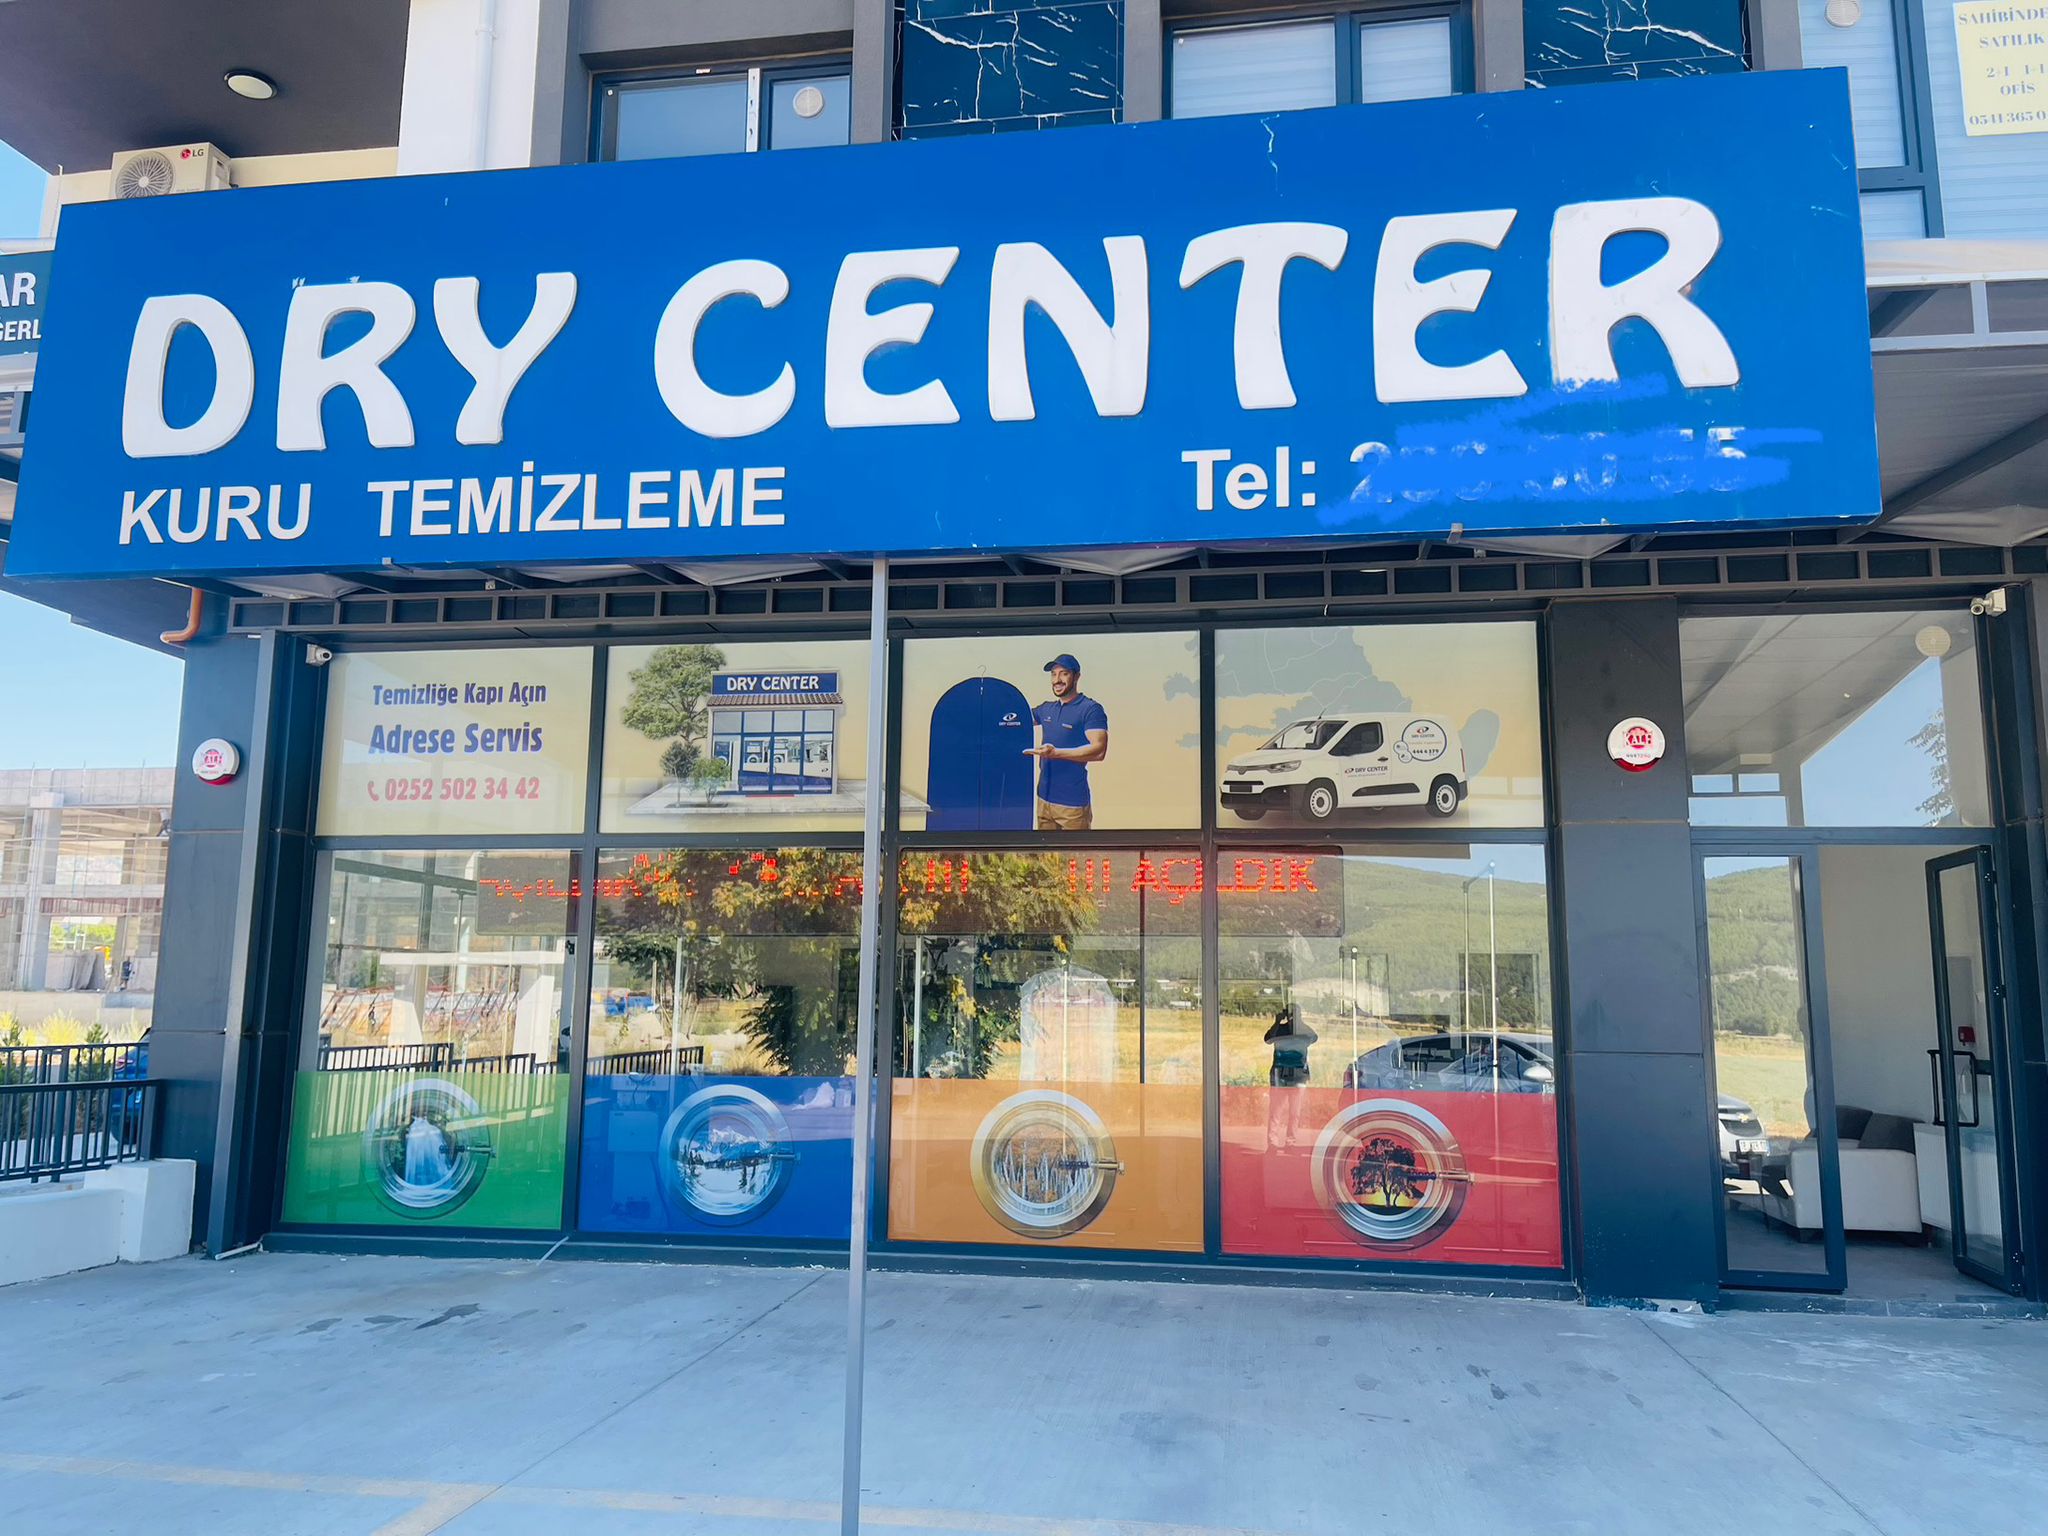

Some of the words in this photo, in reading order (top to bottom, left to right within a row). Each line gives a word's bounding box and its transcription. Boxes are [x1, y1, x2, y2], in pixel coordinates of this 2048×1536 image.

[1980, 33, 2045, 48] SATILIK
[2000, 81, 2035, 95] OFİS
[192, 149, 204, 157] LG
[120, 271, 578, 460] DRY
[653, 196, 1741, 439] CENTER
[1181, 446, 1318, 512] Tel:
[119, 483, 312, 546] KURU
[366, 460, 787, 540] TEMİZLEME
[373, 684, 458, 706] Temizliğe
[464, 682, 504, 705] Kapı
[508, 682, 547, 707] Açın
[726, 677, 757, 691] DRY
[761, 676, 819, 690] CENTER
[369, 724, 456, 754] Adrese
[464, 722, 543, 752] Servis
[385, 778, 433, 801] 0252
[440, 777, 477, 800] 502
[483, 777, 508, 800] 34
[515, 776, 540, 800] 42
